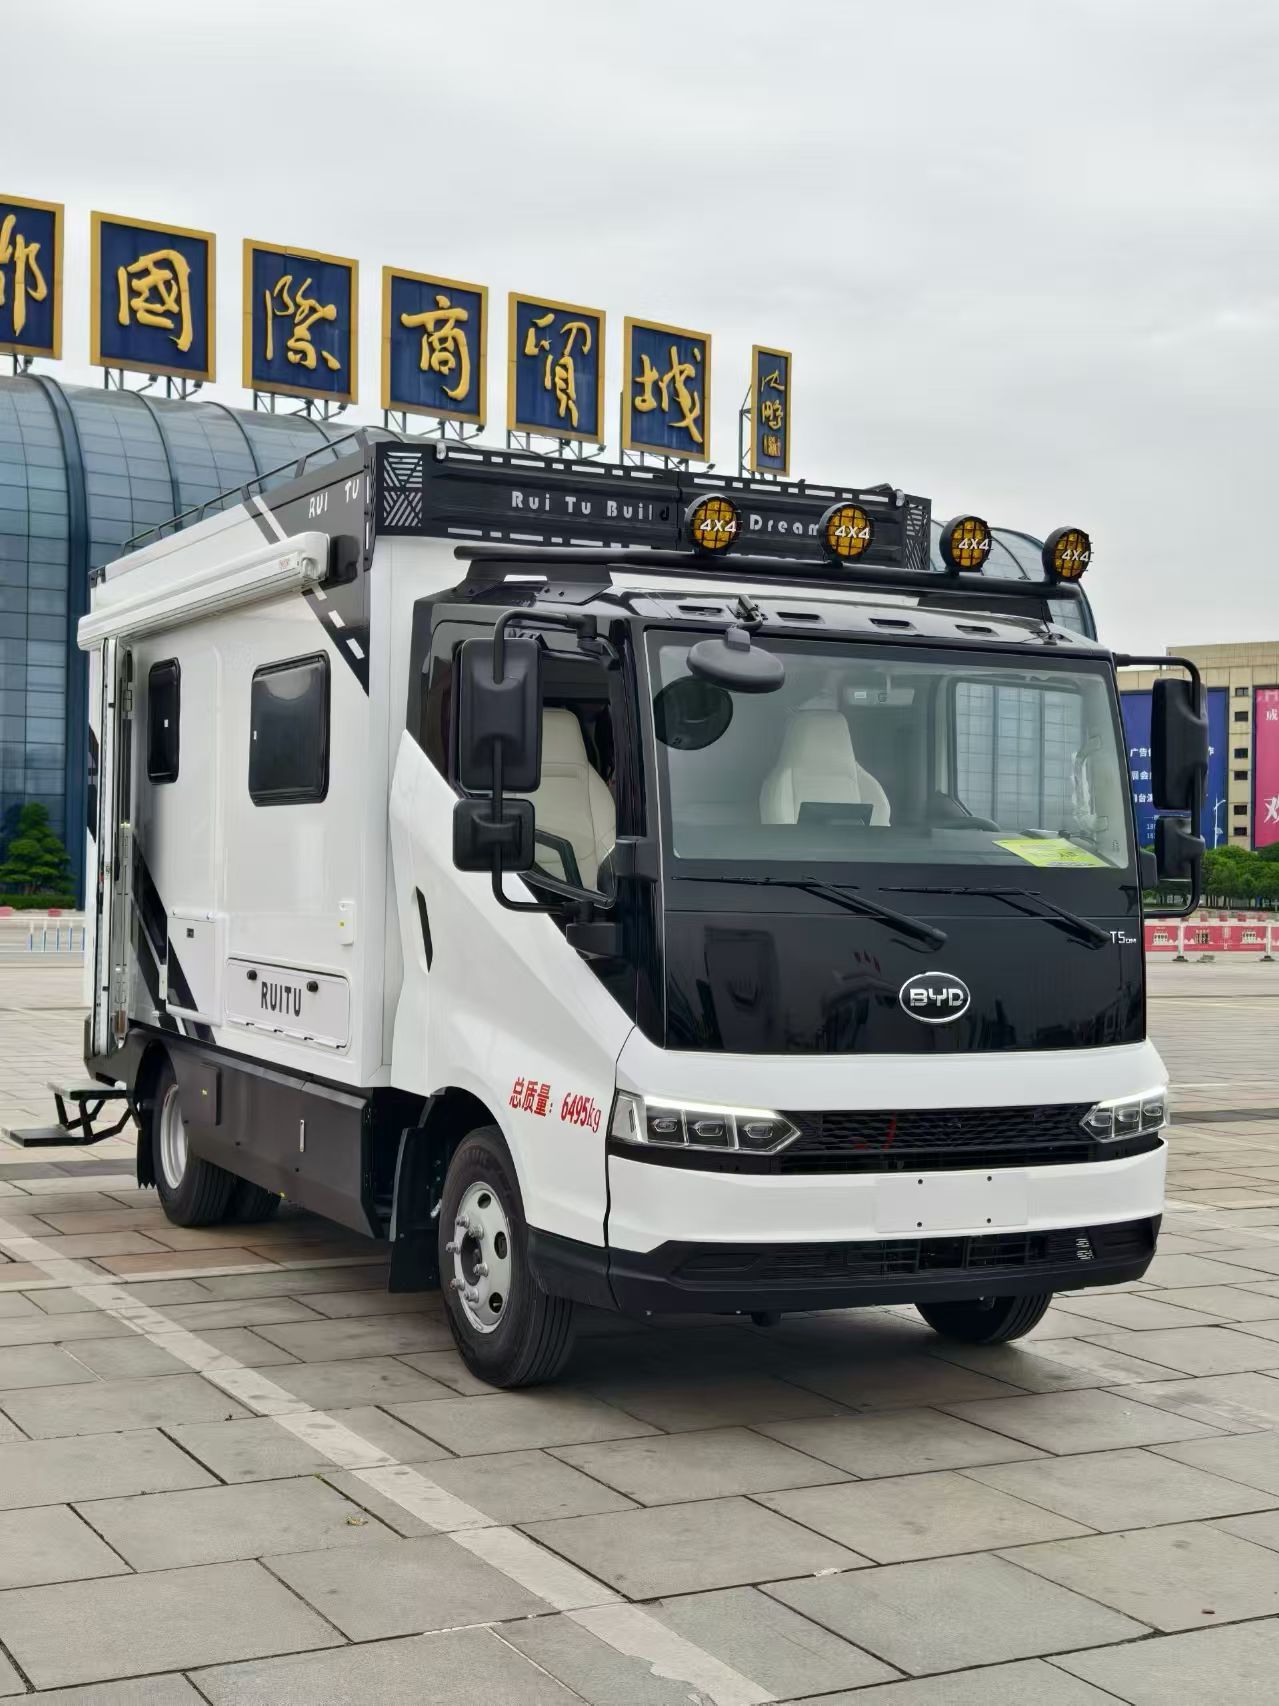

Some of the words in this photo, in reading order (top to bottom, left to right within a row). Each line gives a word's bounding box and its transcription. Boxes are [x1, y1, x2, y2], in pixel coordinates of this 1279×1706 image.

[308, 491, 329, 519] RUI
[344, 478, 360, 503] TU
[511, 490, 550, 511] Rui
[565, 496, 592, 515] Tu
[606, 500, 670, 521] Build
[261, 981, 302, 1017] RUITU
[909, 988, 964, 1007] BYD
[560, 1092, 602, 1134] 6495kg
